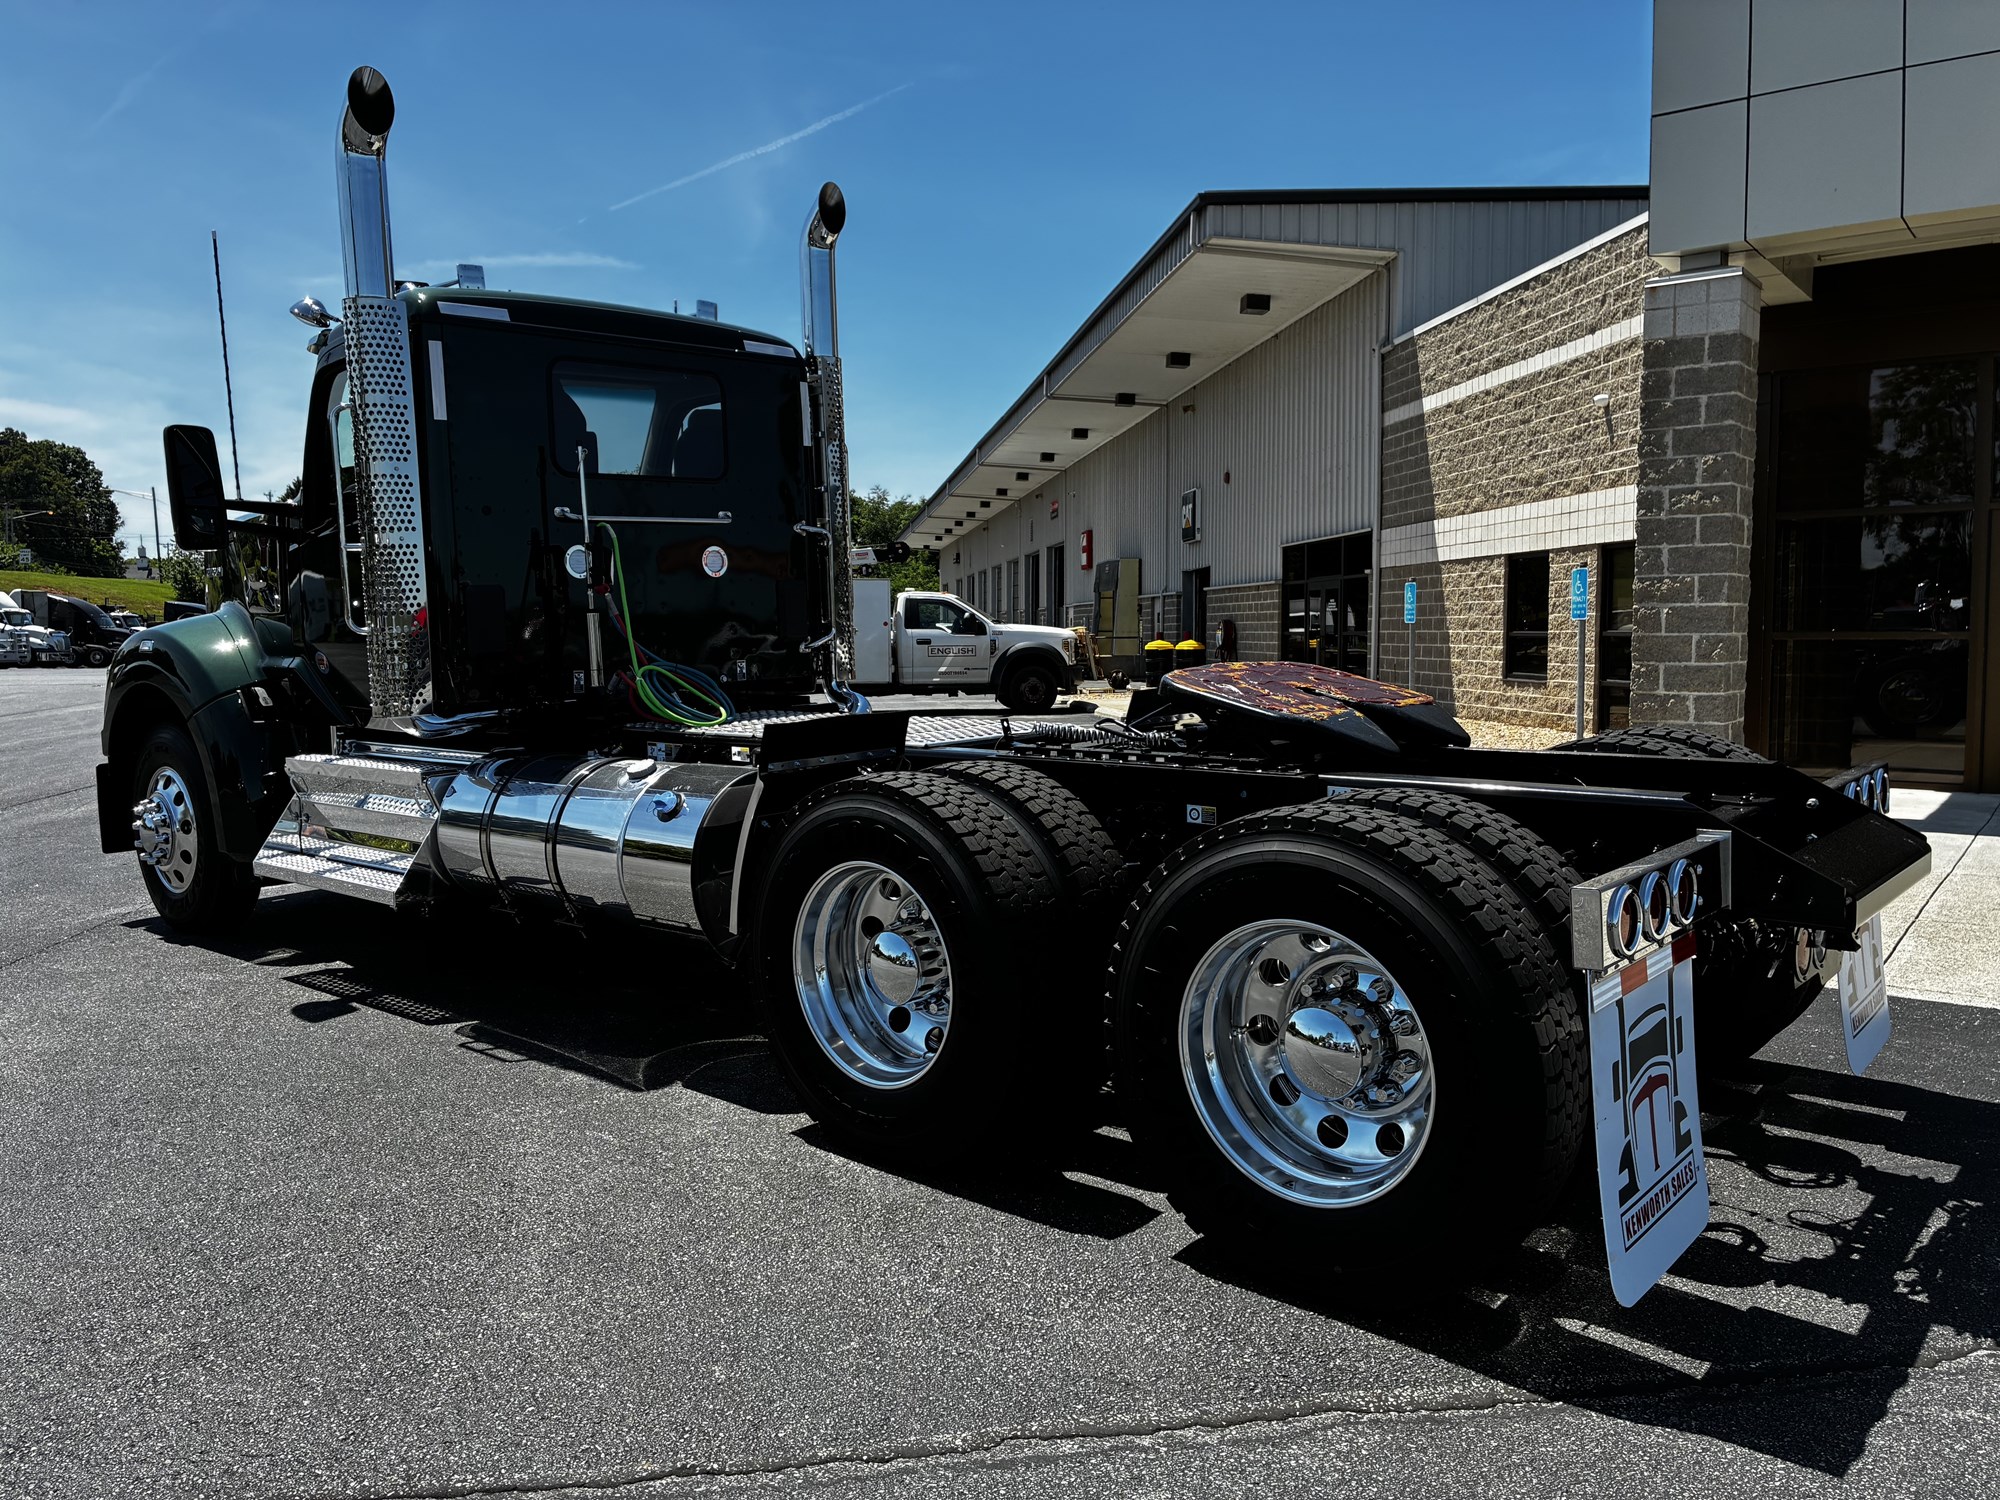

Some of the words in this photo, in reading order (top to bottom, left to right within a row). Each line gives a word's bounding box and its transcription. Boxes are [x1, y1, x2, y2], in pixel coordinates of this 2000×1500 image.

[930, 647, 974, 655] ENGLISH
[1625, 1182, 1671, 1241] KENWORTH
[1671, 1160, 1694, 1197] SALES
